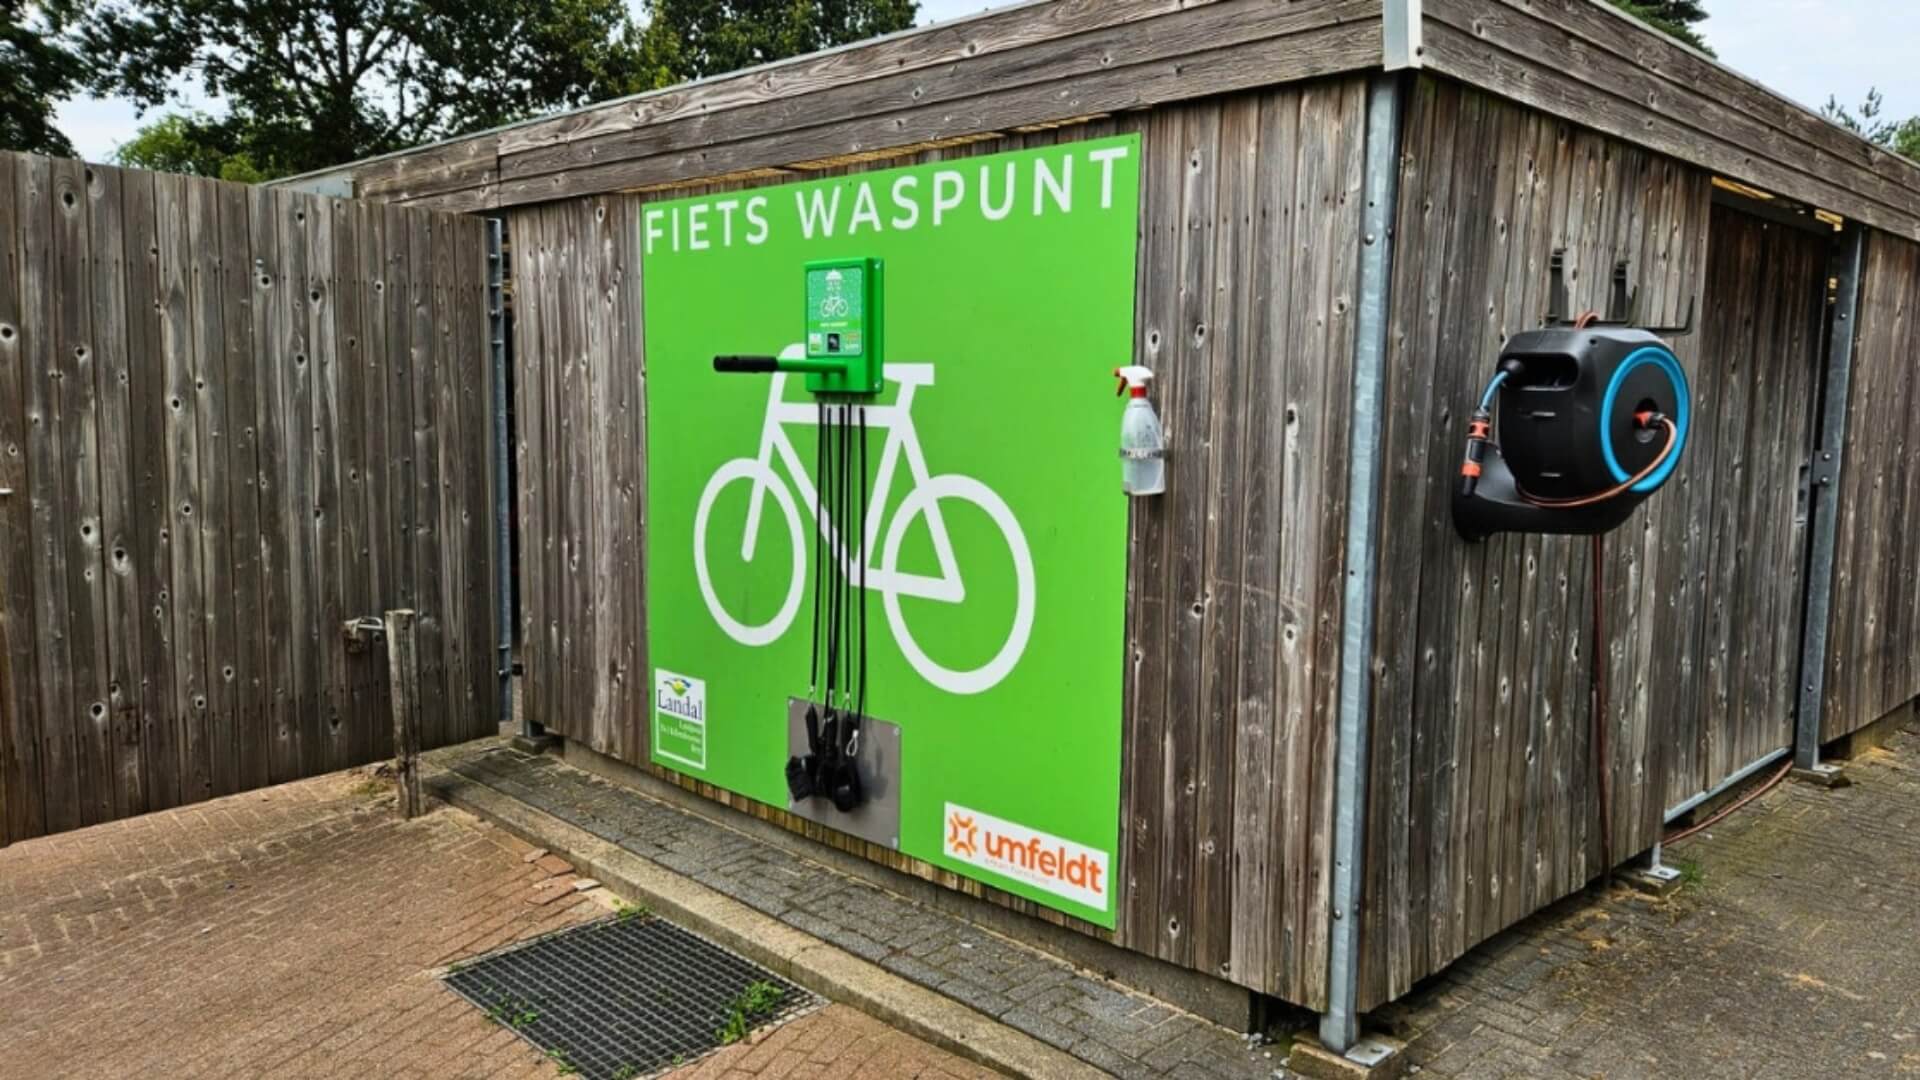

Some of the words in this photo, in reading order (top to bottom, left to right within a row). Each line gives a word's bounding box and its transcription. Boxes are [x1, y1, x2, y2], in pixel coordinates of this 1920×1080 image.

[646, 197, 769, 254] FIETS
[796, 147, 1128, 239] WASPUNT
[658, 689, 703, 721] Landal
[985, 831, 1103, 894] umfeldt
